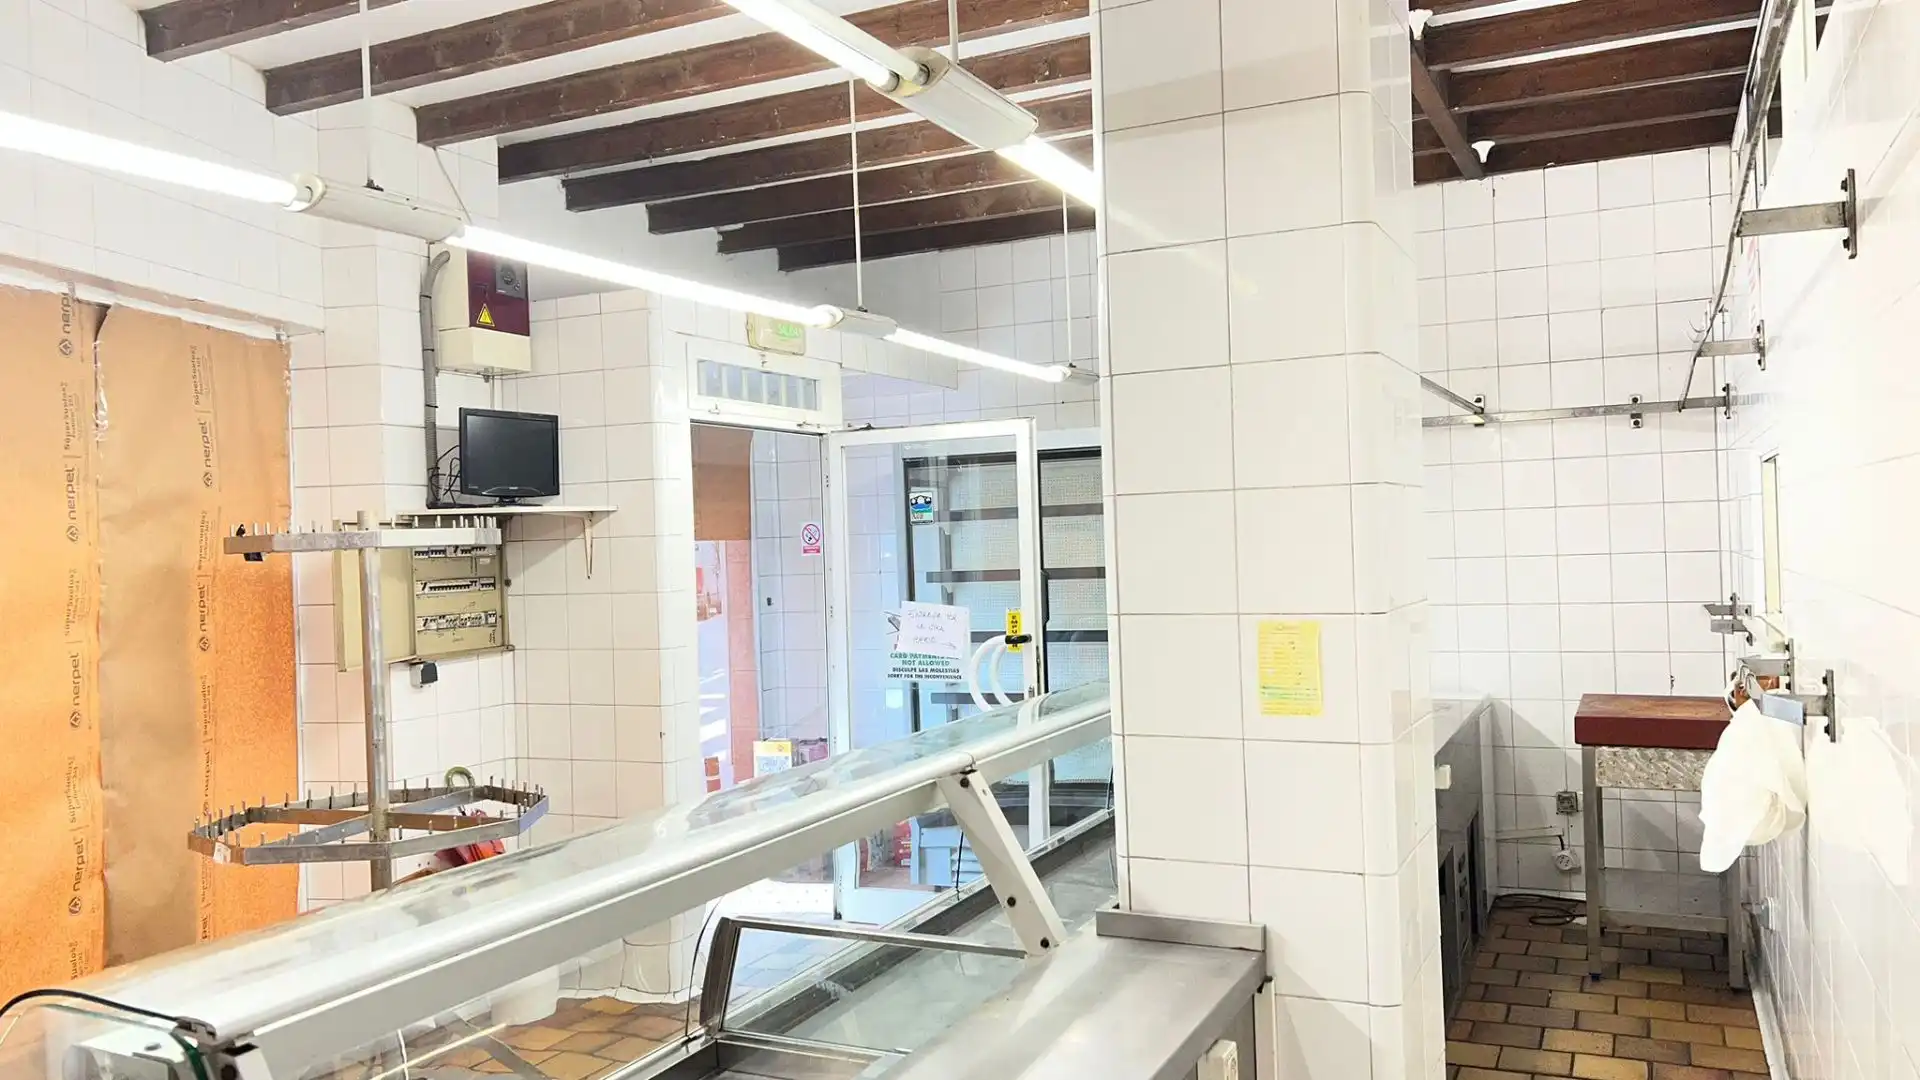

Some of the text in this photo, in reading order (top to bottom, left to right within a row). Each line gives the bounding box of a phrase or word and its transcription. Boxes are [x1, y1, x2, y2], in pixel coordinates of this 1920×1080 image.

[64, 466, 77, 520] nerpel
[197, 585, 207, 632] nerpel
[1010, 615, 1019, 648] EMPUR
[68, 652, 81, 706] nerpel
[71, 837, 86, 892] nerpel
